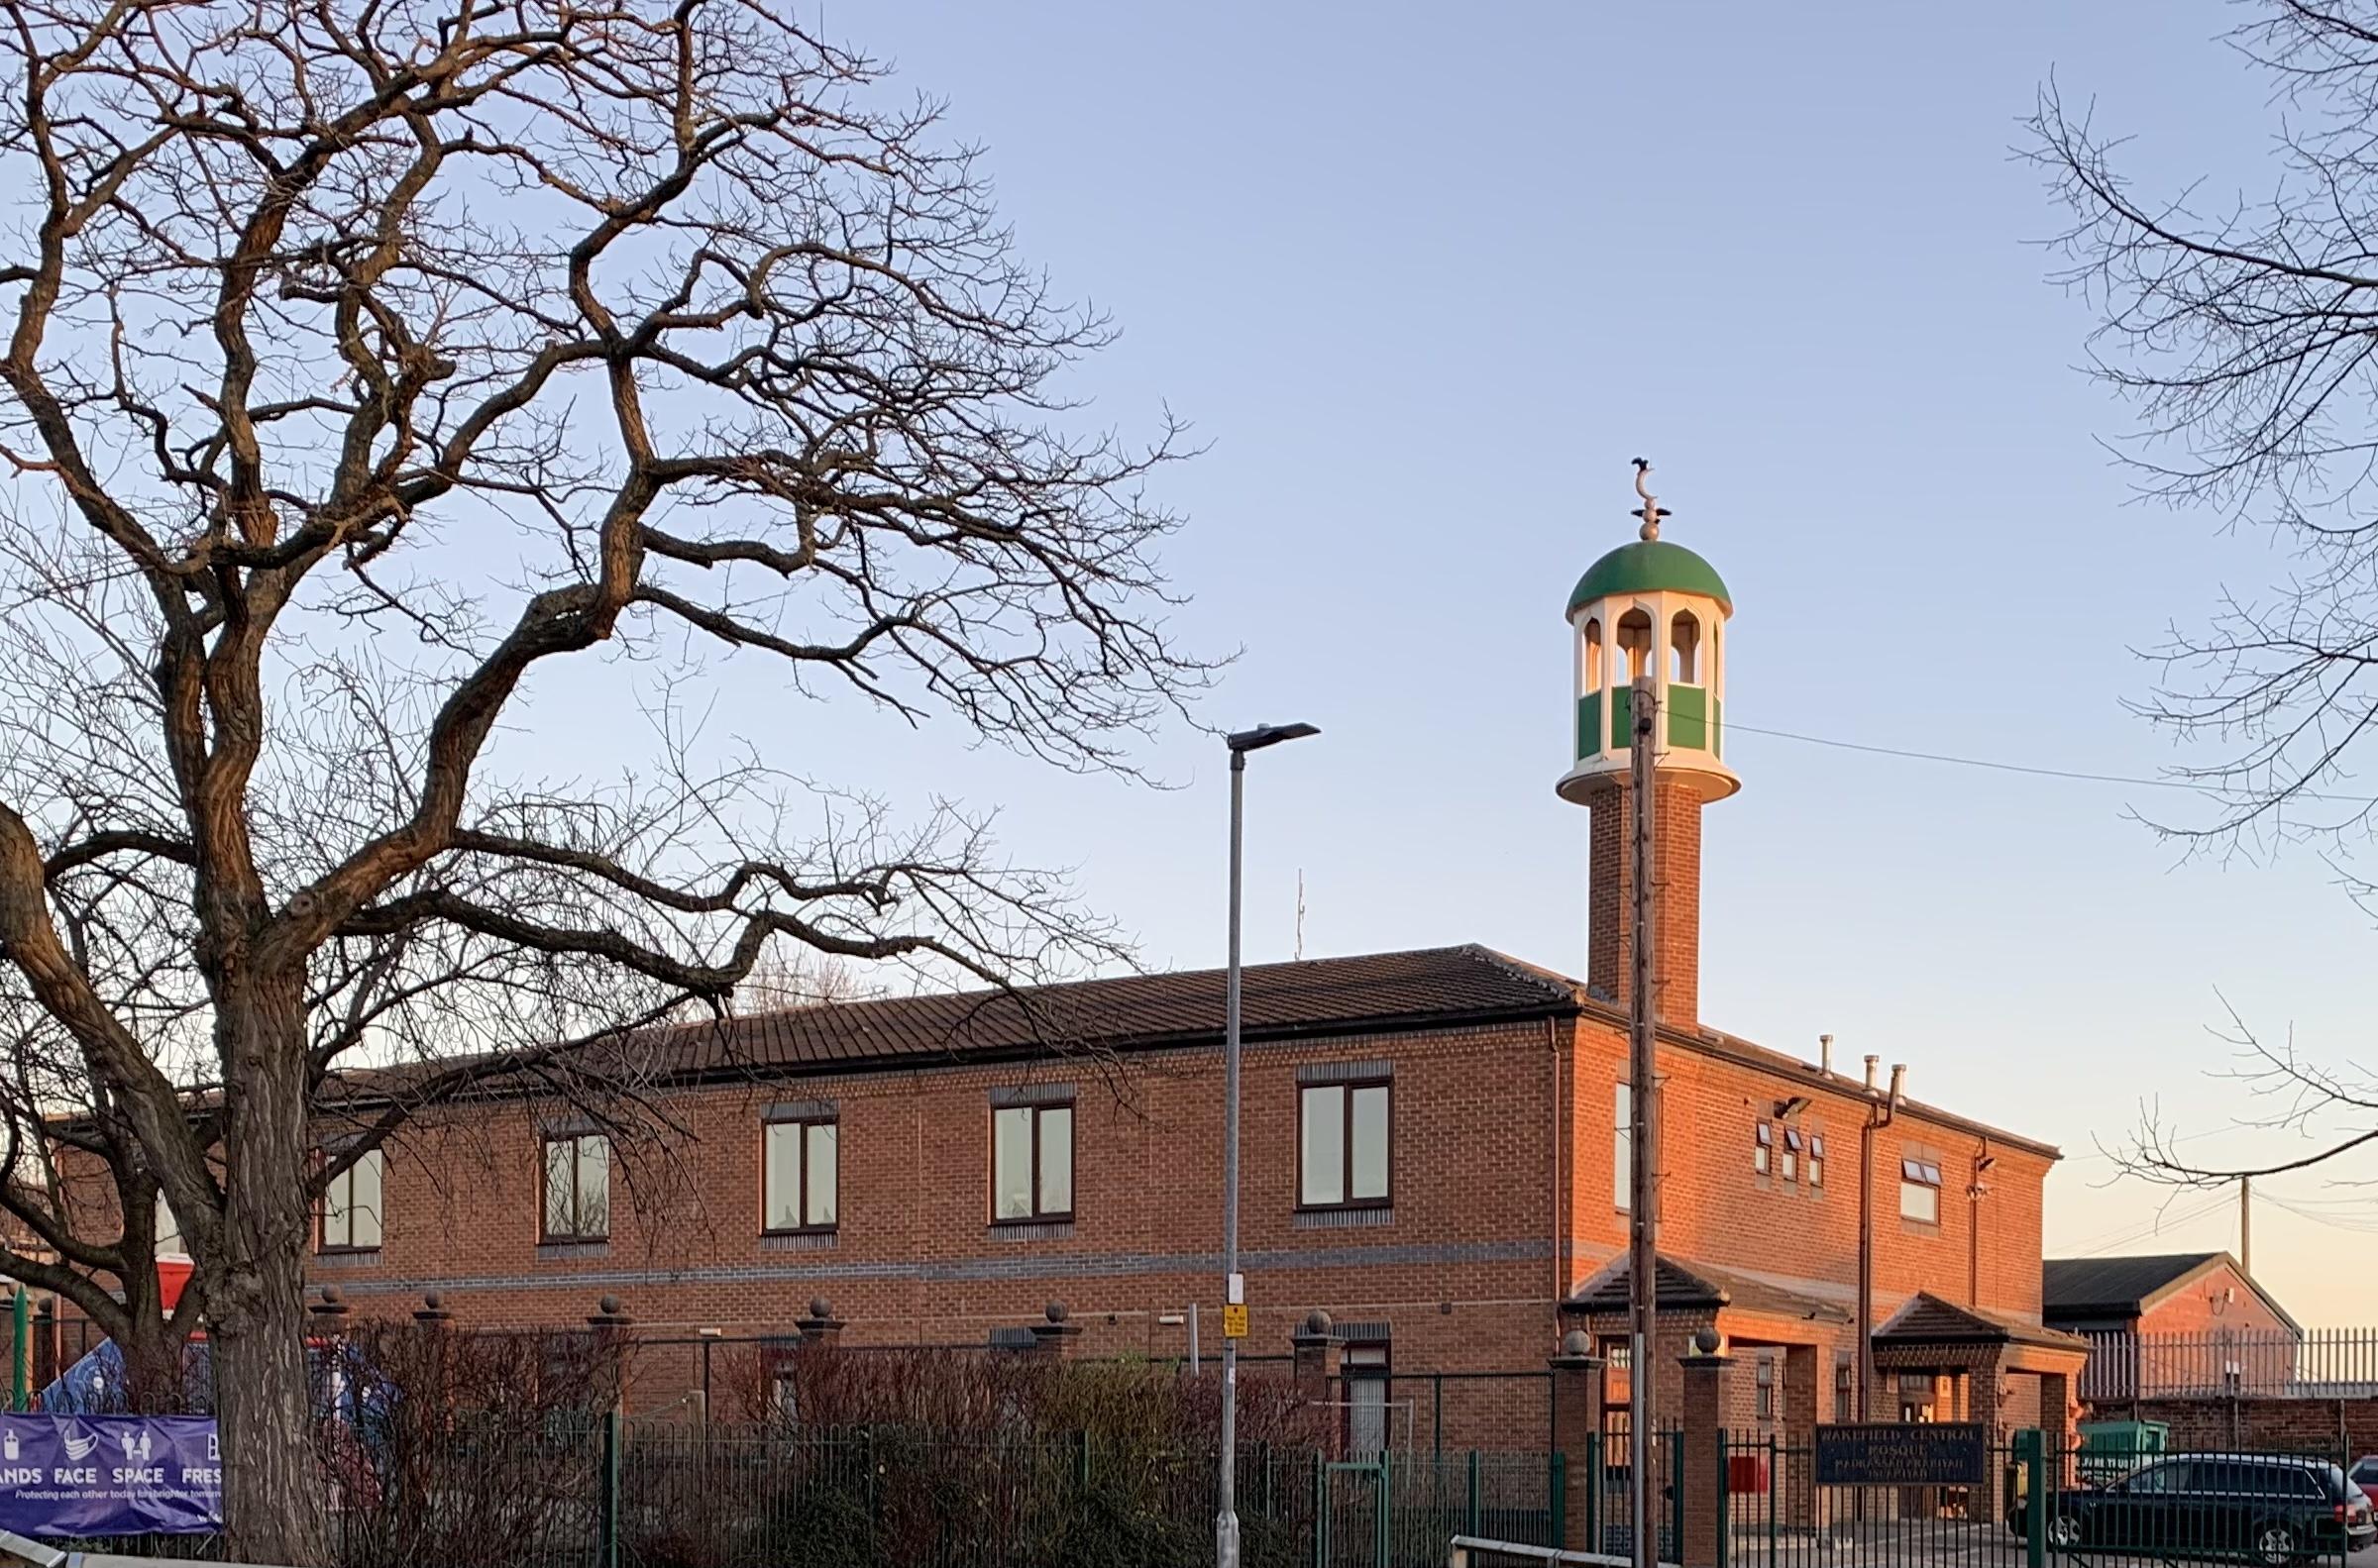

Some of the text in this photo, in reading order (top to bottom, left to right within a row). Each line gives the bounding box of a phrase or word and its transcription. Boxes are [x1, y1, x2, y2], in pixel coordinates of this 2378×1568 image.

[1821, 1429, 1976, 1440] WAKEFIELD CENTRAL
[1869, 1444, 1928, 1456] MOSQUE
[0, 1467, 43, 1484] NDS
[54, 1467, 97, 1484] FACE
[111, 1467, 165, 1484] SPACE
[15, 1489, 58, 1501] Protecting
[59, 1490, 80, 1500] each
[82, 1489, 108, 1500] other
[110, 1488, 136, 1500] today
